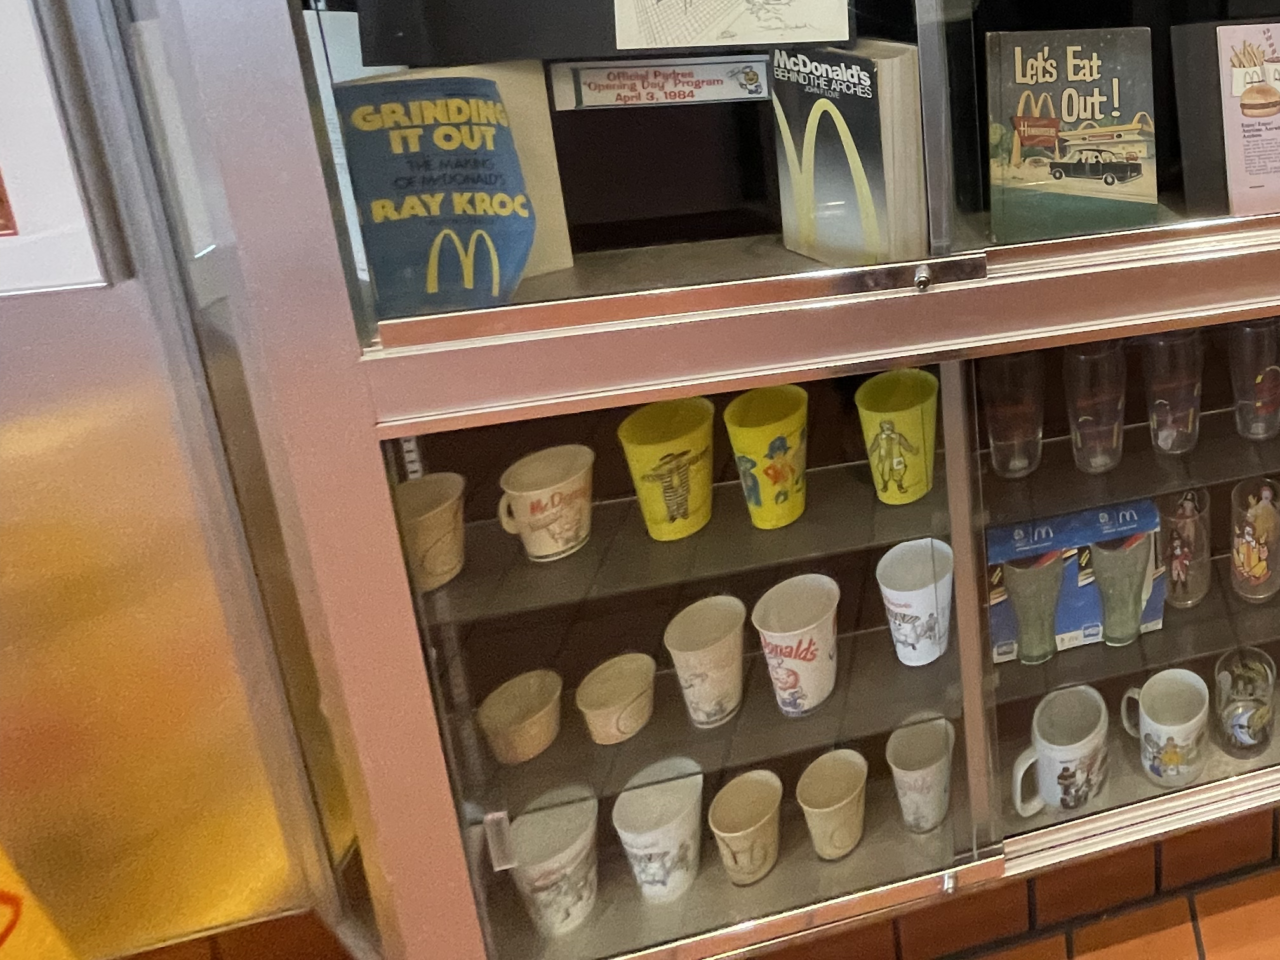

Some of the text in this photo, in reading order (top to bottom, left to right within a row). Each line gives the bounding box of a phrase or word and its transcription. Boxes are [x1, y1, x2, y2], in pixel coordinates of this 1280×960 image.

[606, 69, 695, 82] Official Padres
[774, 49, 871, 86] McDonald's
[1014, 46, 1102, 85] Let's Eat
[674, 78, 724, 89] Program
[773, 67, 872, 99] BEHIND THE ARCHES
[615, 90, 695, 104] April 3, 1984
[825, 89, 840, 99] LOVE
[389, 125, 497, 154] IT OUT
[406, 158, 495, 172] THE MAKING
[371, 192, 530, 223] RAY KROC
